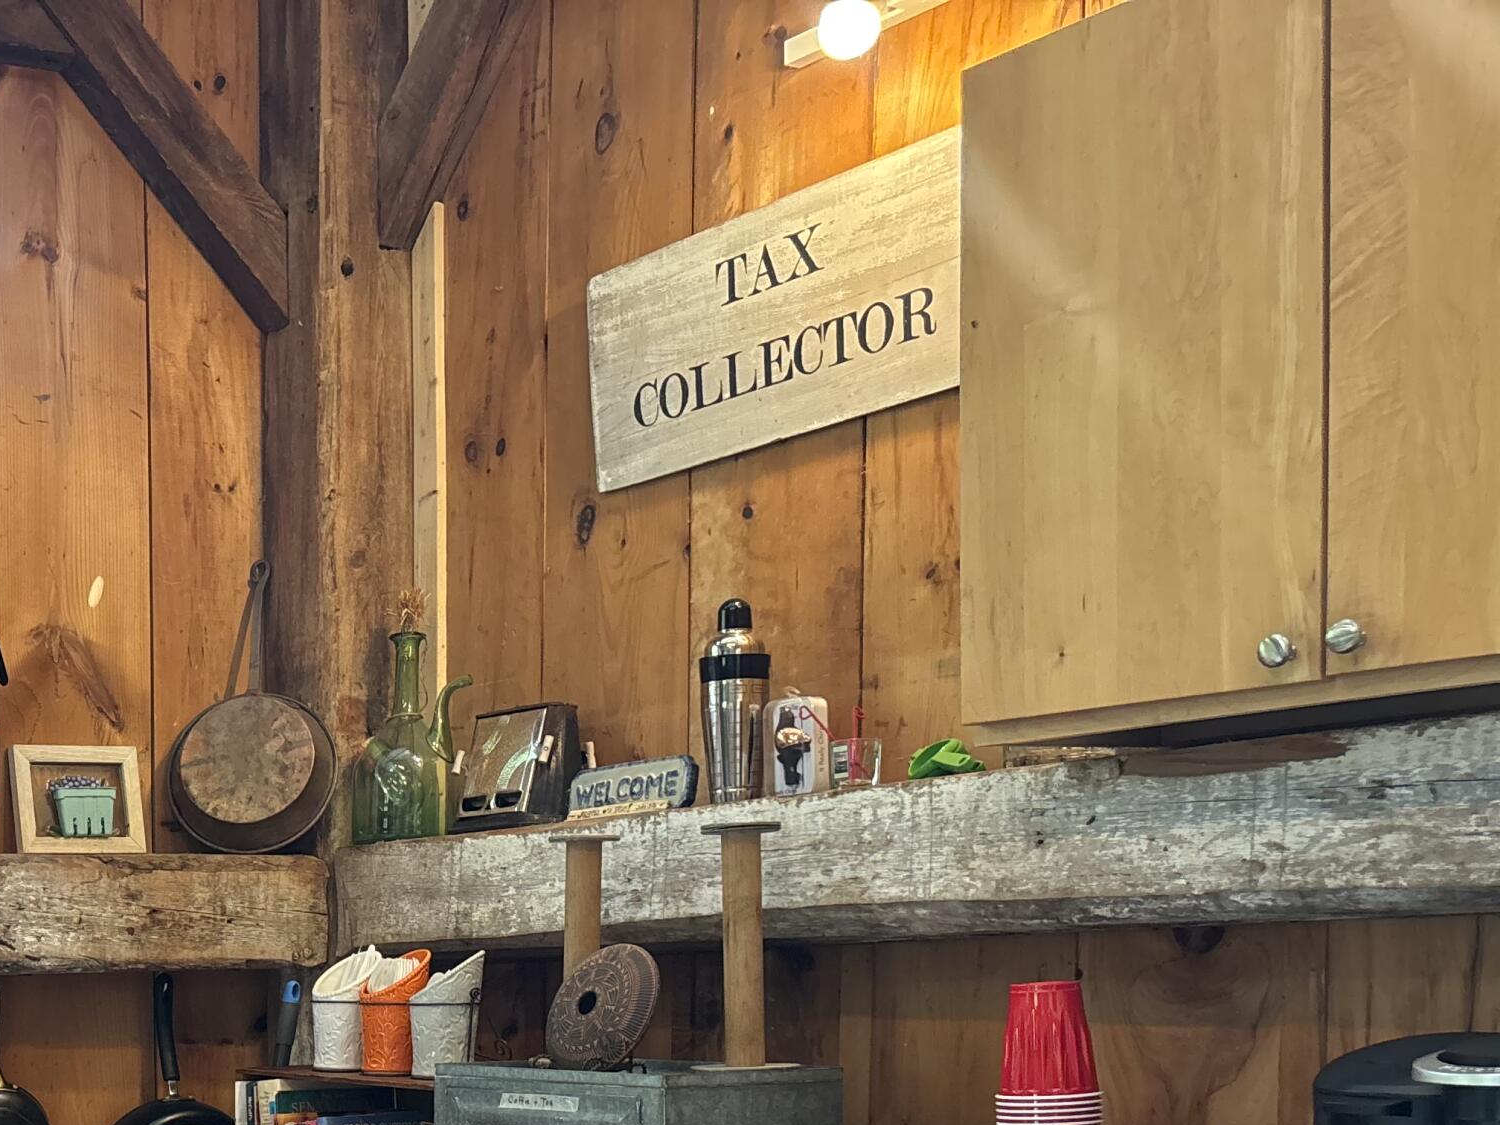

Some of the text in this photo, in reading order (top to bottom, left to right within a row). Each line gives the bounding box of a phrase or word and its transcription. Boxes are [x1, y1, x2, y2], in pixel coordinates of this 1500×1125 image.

[715, 222, 825, 307] TAX
[633, 287, 937, 427] COLLECTOR
[576, 770, 679, 808] WELCOME
